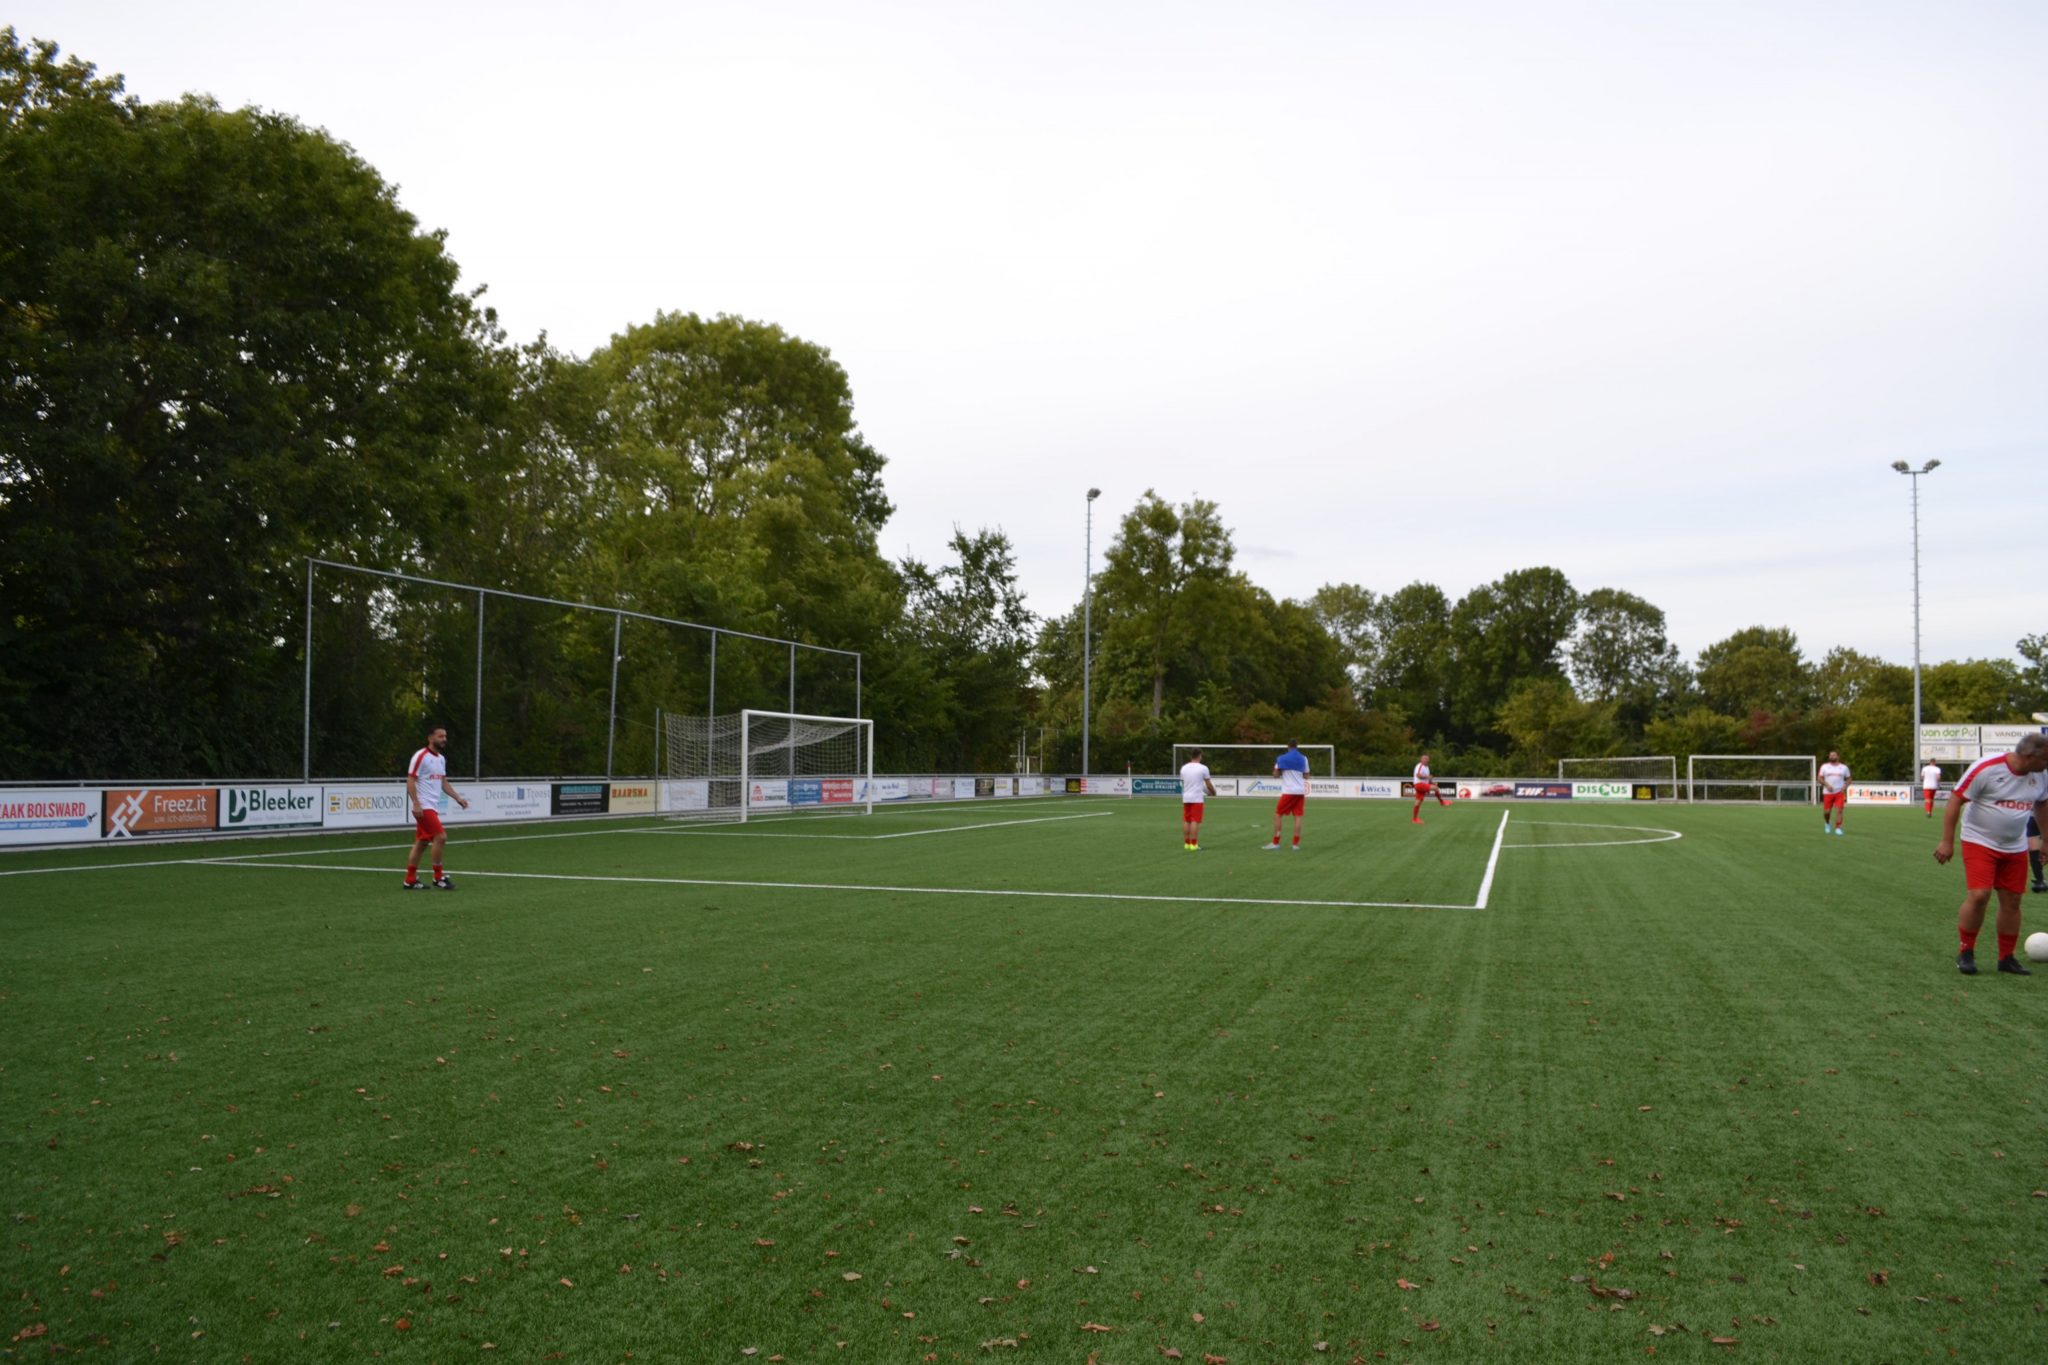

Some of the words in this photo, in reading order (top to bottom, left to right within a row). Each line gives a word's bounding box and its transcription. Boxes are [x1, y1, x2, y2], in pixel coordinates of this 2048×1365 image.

[1366, 784, 1391, 792] Wicks
[1577, 783, 1627, 796] DISCUS
[154, 794, 207, 812] Freez.it
[249, 788, 314, 811] Bleeker
[346, 796, 403, 810] GROENOORD
[27, 802, 86, 818] BOLSWARD
